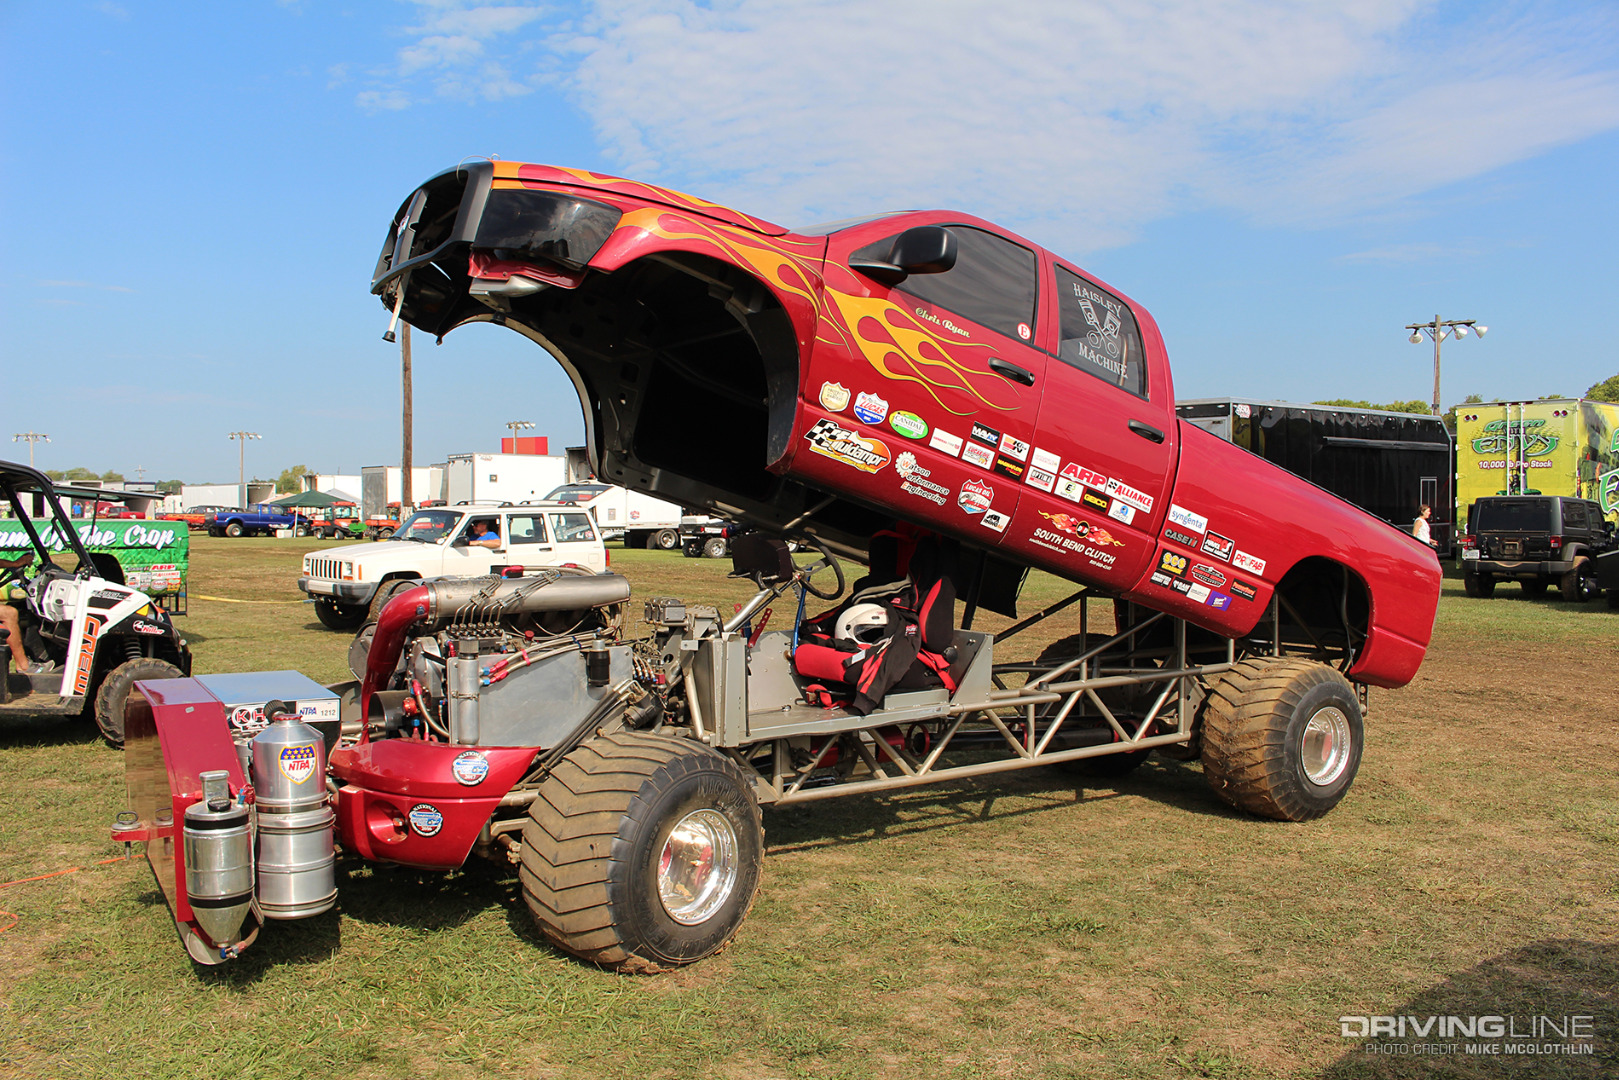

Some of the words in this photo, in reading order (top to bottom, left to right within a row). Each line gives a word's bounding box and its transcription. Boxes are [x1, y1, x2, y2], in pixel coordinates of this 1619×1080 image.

[1073, 283, 1121, 319] HAISLEY
[915, 307, 941, 326] Chris
[942, 319, 971, 338] Ryan
[1079, 341, 1128, 379] MACHINE
[859, 400, 886, 414] LUCAS
[894, 413, 924, 431] CANIDAE
[902, 460, 931, 478] Watson
[1478, 460, 1505, 469] 10,000
[1530, 459, 1552, 468] Stock
[902, 471, 950, 496] Performance
[1063, 463, 1107, 487] ARP
[902, 482, 947, 506] Engineering
[965, 483, 982, 494] LUCAS
[982, 489, 991, 497] OIL
[1114, 484, 1153, 507] ALLIANCE
[1083, 493, 1107, 509] GEICO
[1171, 510, 1203, 529] syngenta
[78, 525, 117, 547] The
[123, 524, 175, 550] Crop
[1164, 528, 1189, 545] CASE
[1033, 527, 1064, 545] SOUTH
[1061, 538, 1086, 553] BEND
[1084, 547, 1117, 565] CLUTCH
[1163, 552, 1187, 569] SCS
[74, 615, 101, 695] CREW
[299, 707, 317, 716] NTPA
[458, 751, 485, 760] NATIONAL
[288, 760, 310, 771] NTPA
[413, 804, 437, 813] NATIONAL
